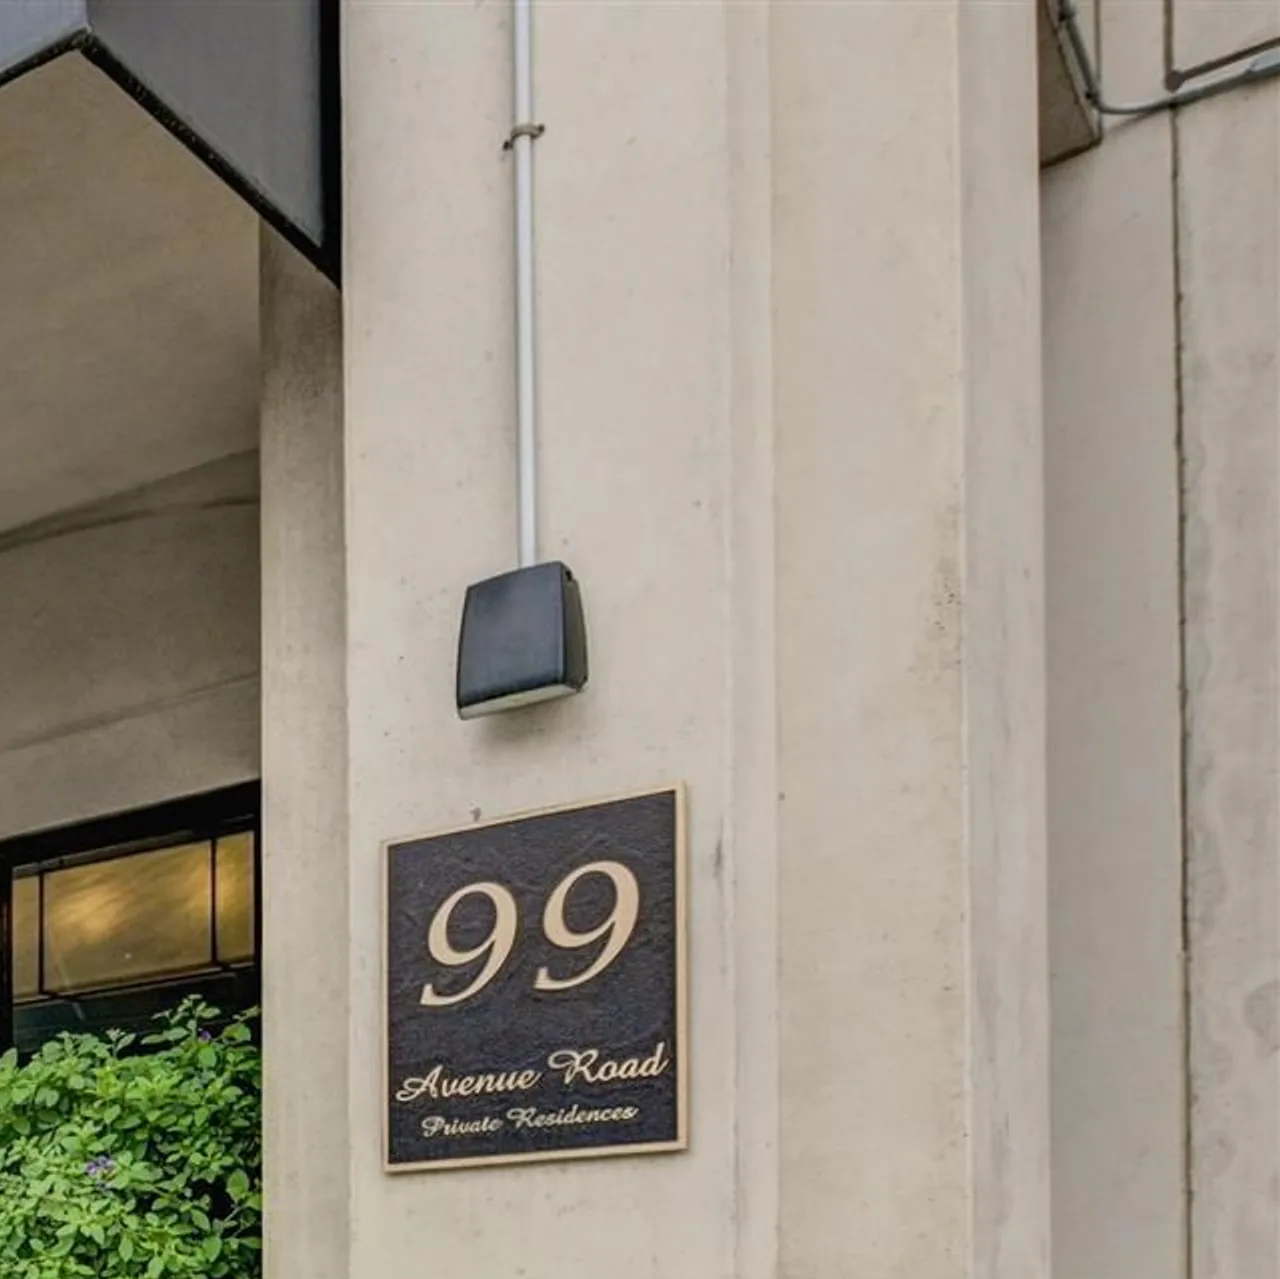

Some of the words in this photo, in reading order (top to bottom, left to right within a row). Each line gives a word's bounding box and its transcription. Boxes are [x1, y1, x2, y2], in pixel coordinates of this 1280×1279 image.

[419, 860, 640, 1007] 99
[395, 1064, 543, 1102] Avenue
[547, 1041, 670, 1085] Road
[421, 1114, 504, 1138] Private
[506, 1104, 641, 1129] Residences
